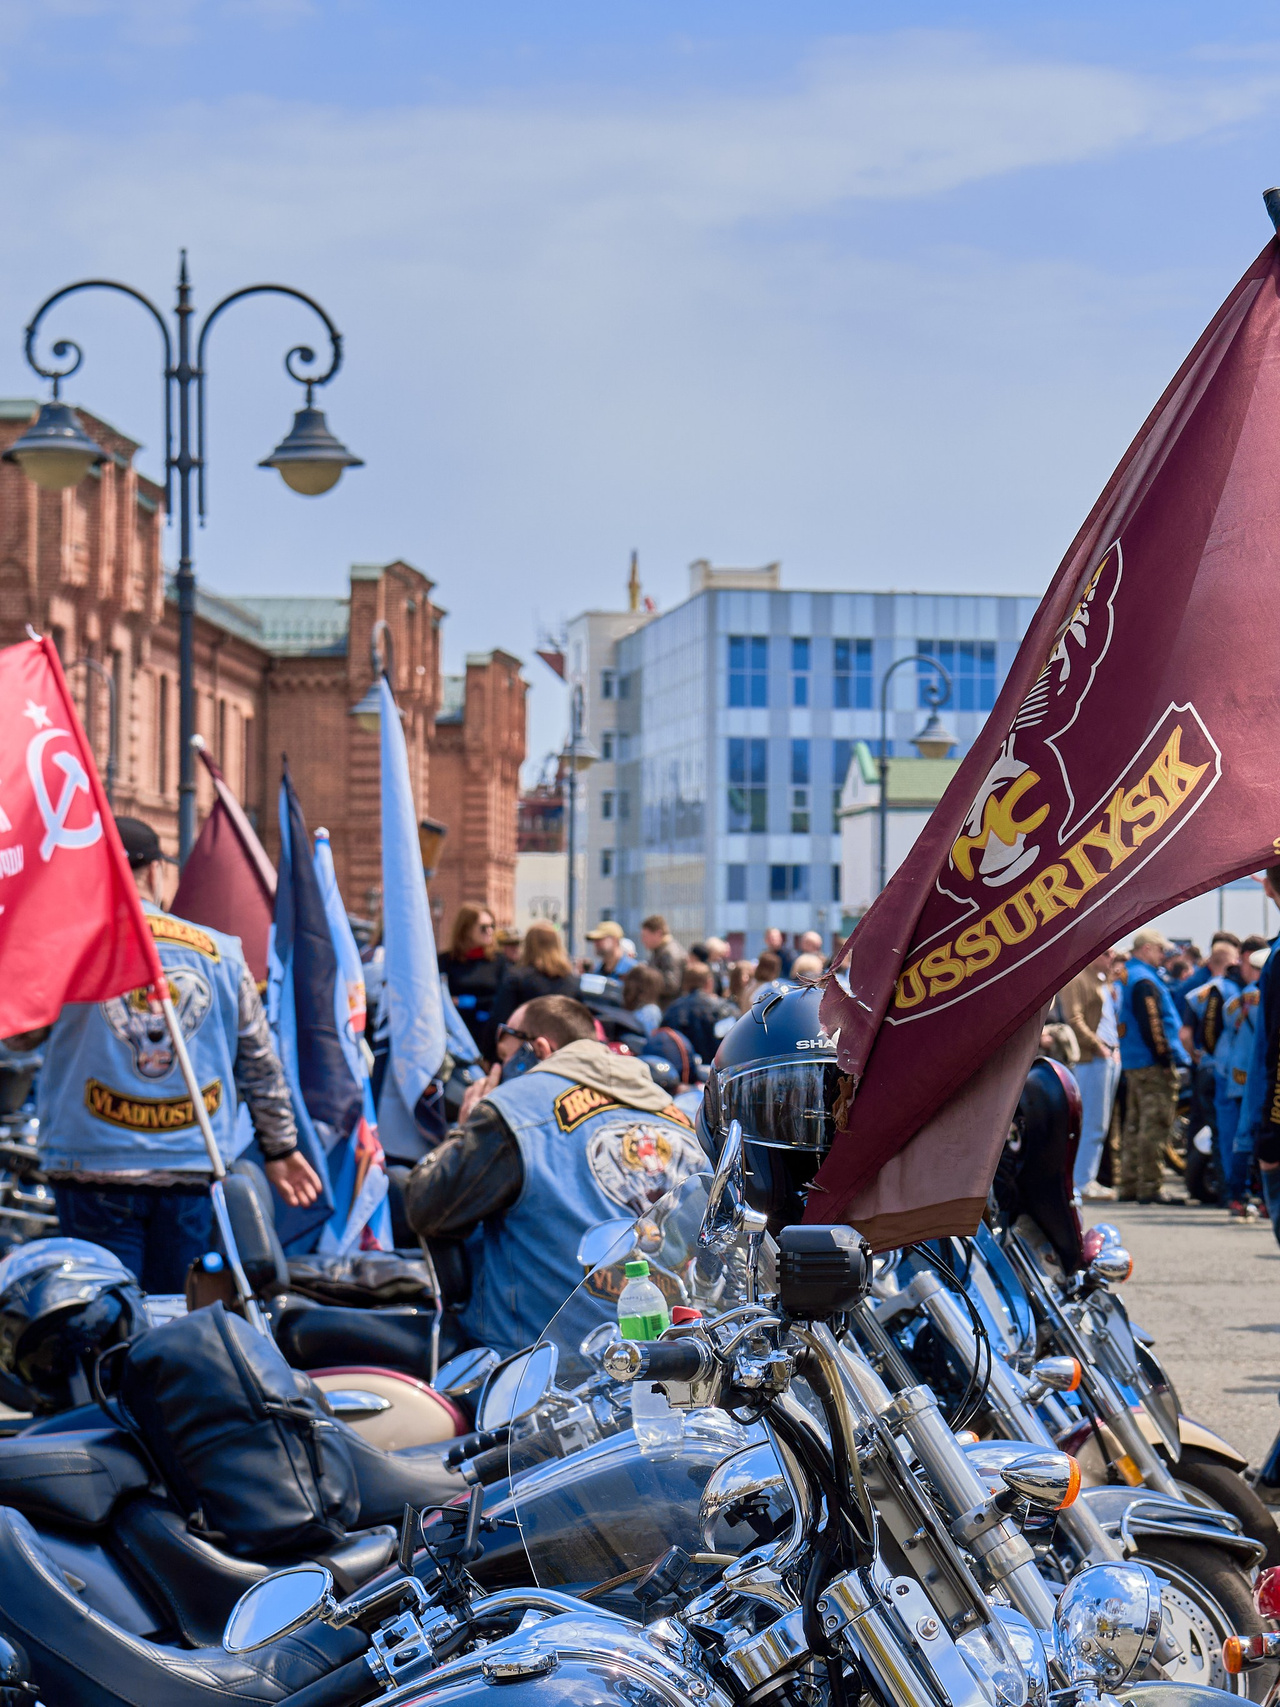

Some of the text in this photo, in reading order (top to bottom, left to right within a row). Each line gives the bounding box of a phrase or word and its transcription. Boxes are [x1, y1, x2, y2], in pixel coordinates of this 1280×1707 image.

[951, 770, 1050, 881] MC
[894, 725, 1211, 1009] USSURIYSK
[796, 1039, 838, 1050] SHA
[92, 1087, 218, 1128] VLADIVOSTK
